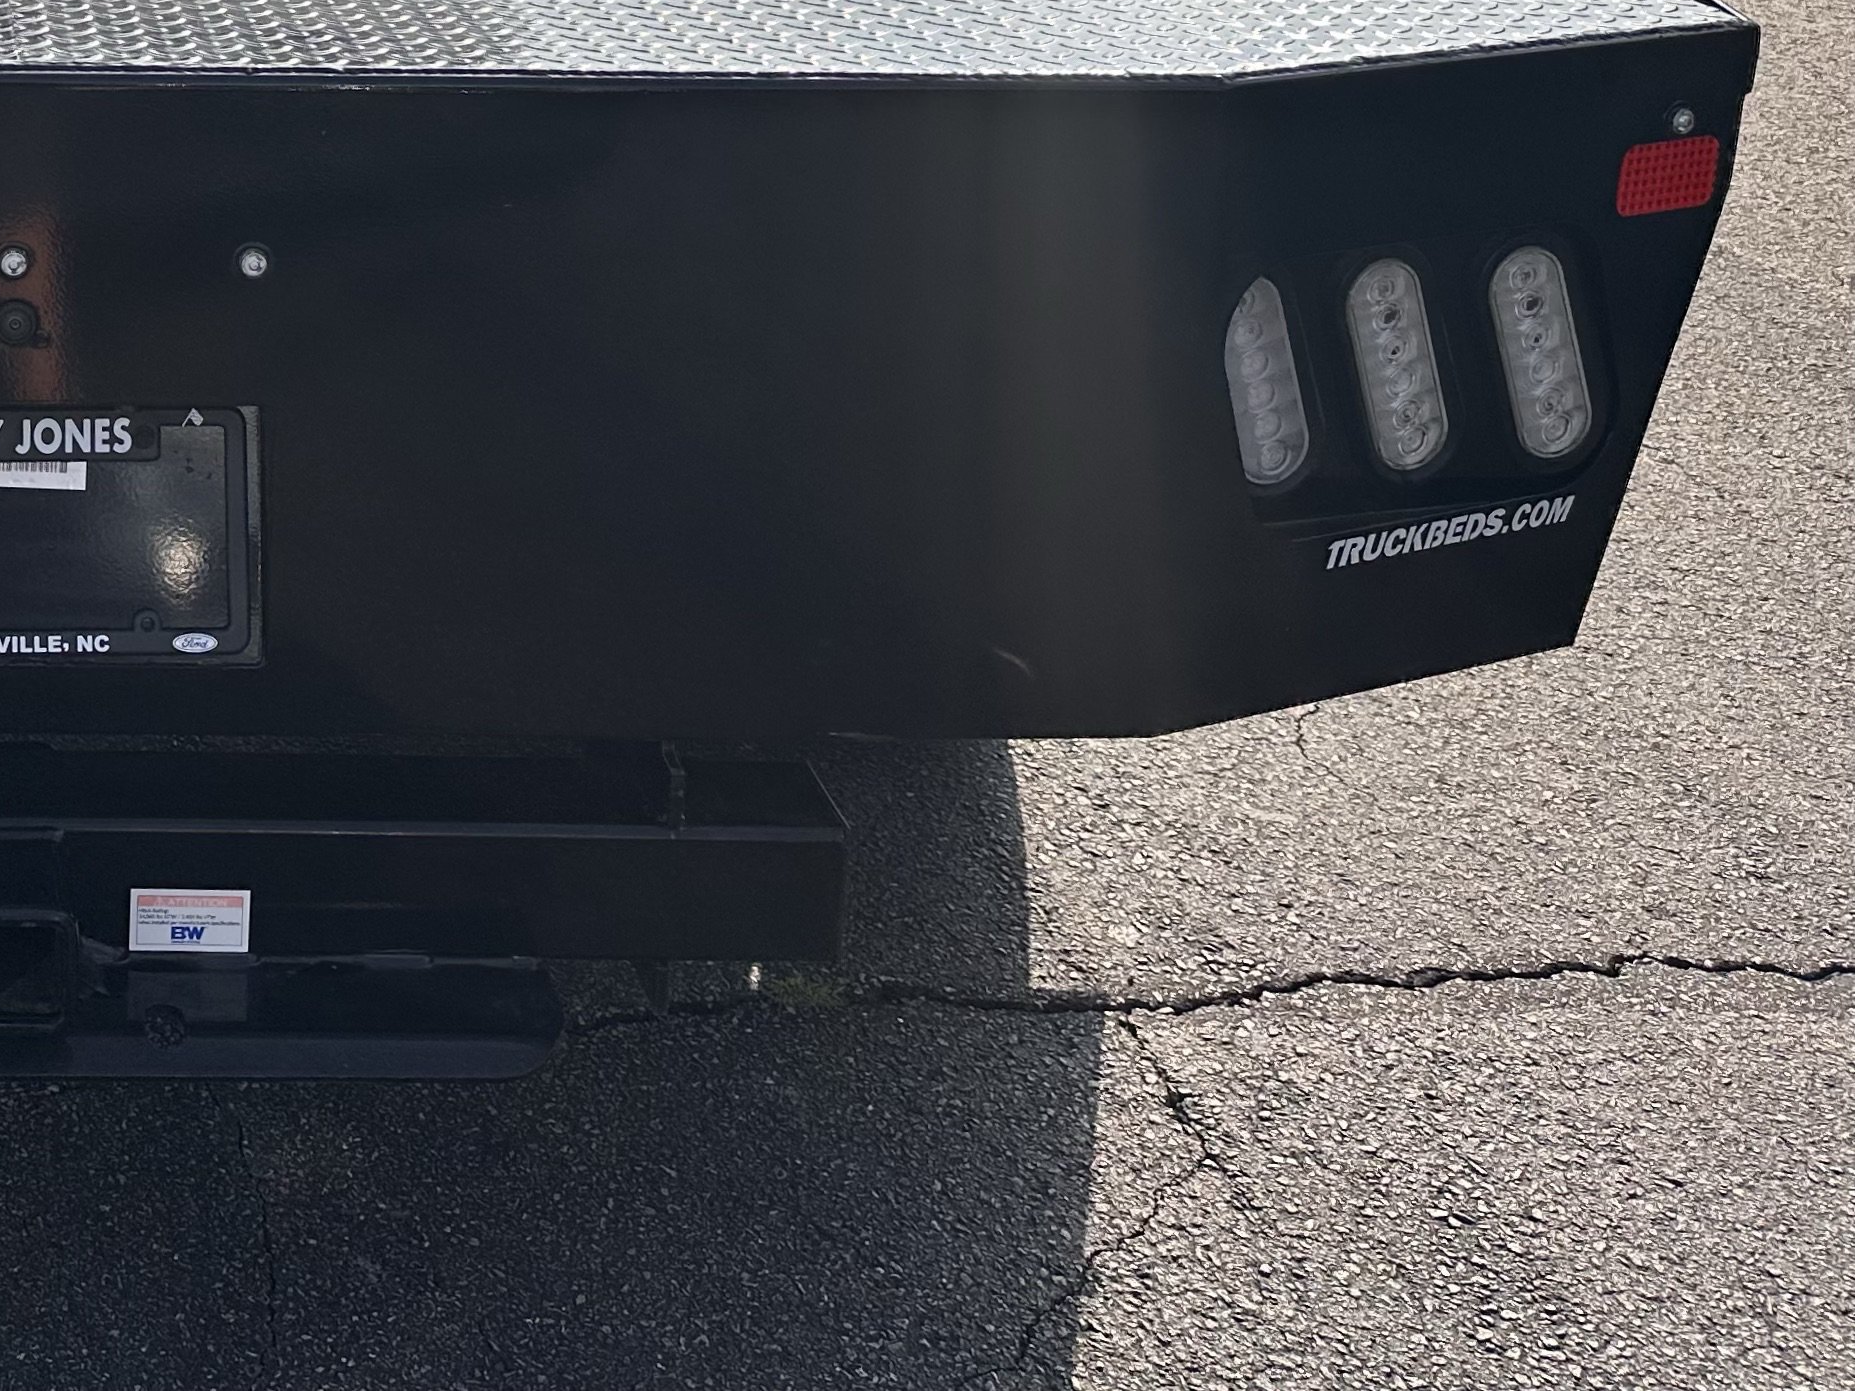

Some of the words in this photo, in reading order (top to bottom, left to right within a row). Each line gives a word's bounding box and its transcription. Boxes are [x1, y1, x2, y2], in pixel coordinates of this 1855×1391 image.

[15, 417, 133, 455] JONES
[1326, 494, 1576, 570] TRUCKBEDS.COM
[76, 634, 111, 653] NC
[181, 636, 209, 649] Ford
